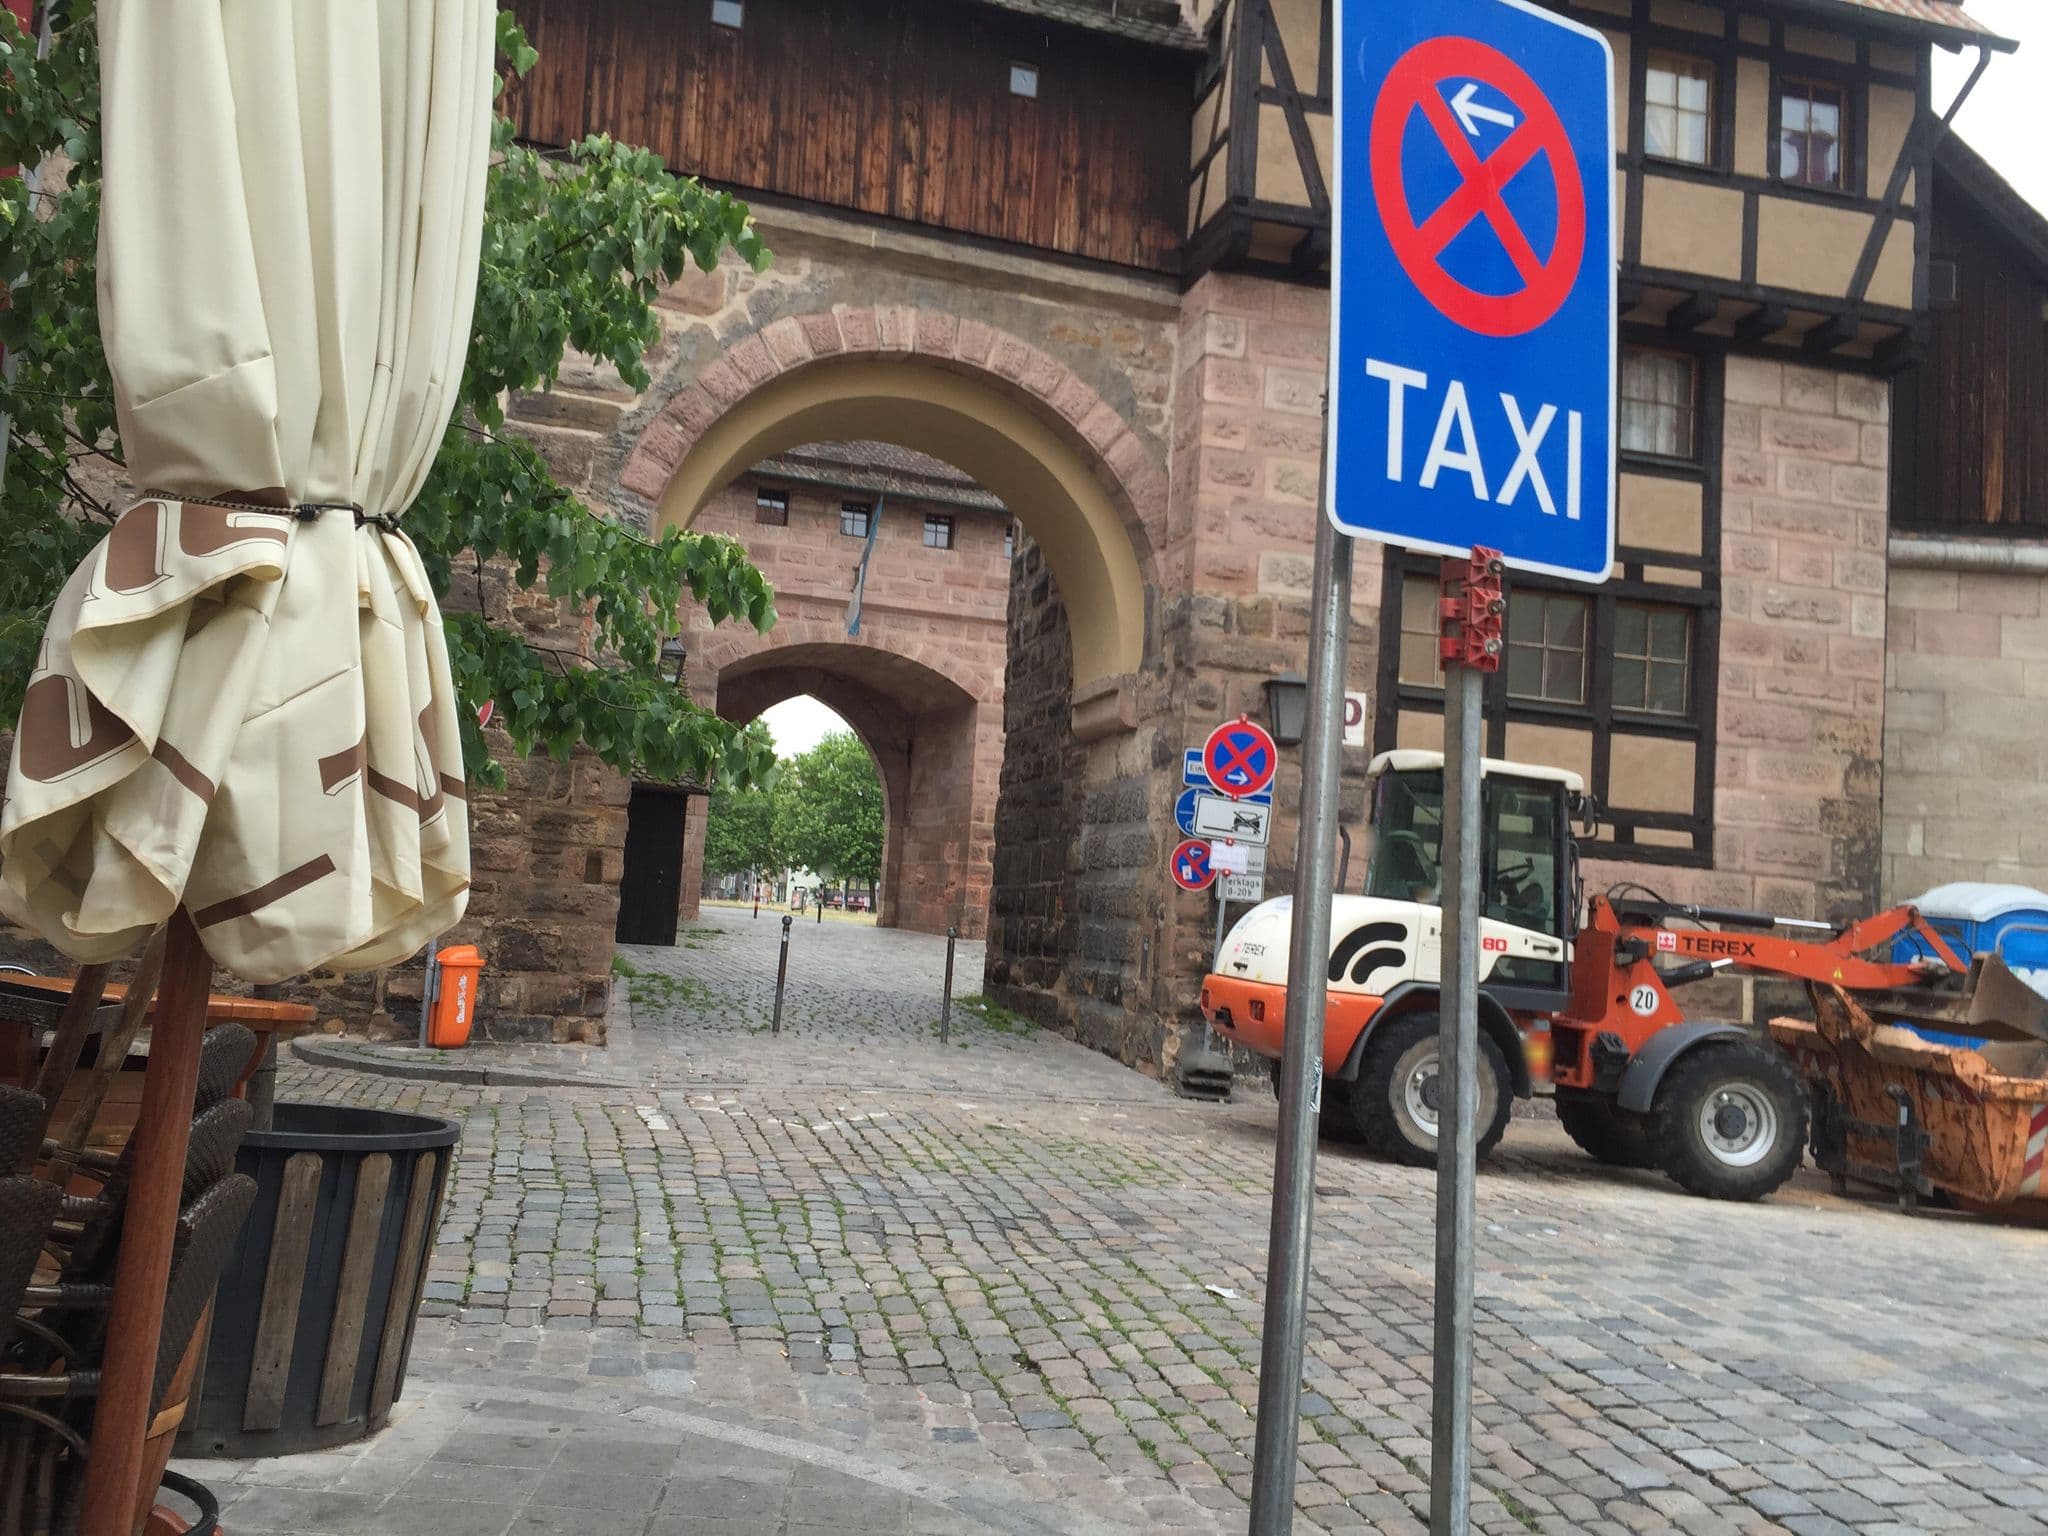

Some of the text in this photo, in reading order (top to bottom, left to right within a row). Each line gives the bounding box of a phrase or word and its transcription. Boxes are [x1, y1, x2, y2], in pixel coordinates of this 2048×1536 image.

[1365, 357, 1582, 521] TAXI
[1220, 877, 1260, 889] erktags
[1242, 942, 1267, 957] TEREX
[1482, 938, 1507, 952] 80
[1682, 936, 1755, 957] TEREX
[1635, 989, 1654, 1009] 20
